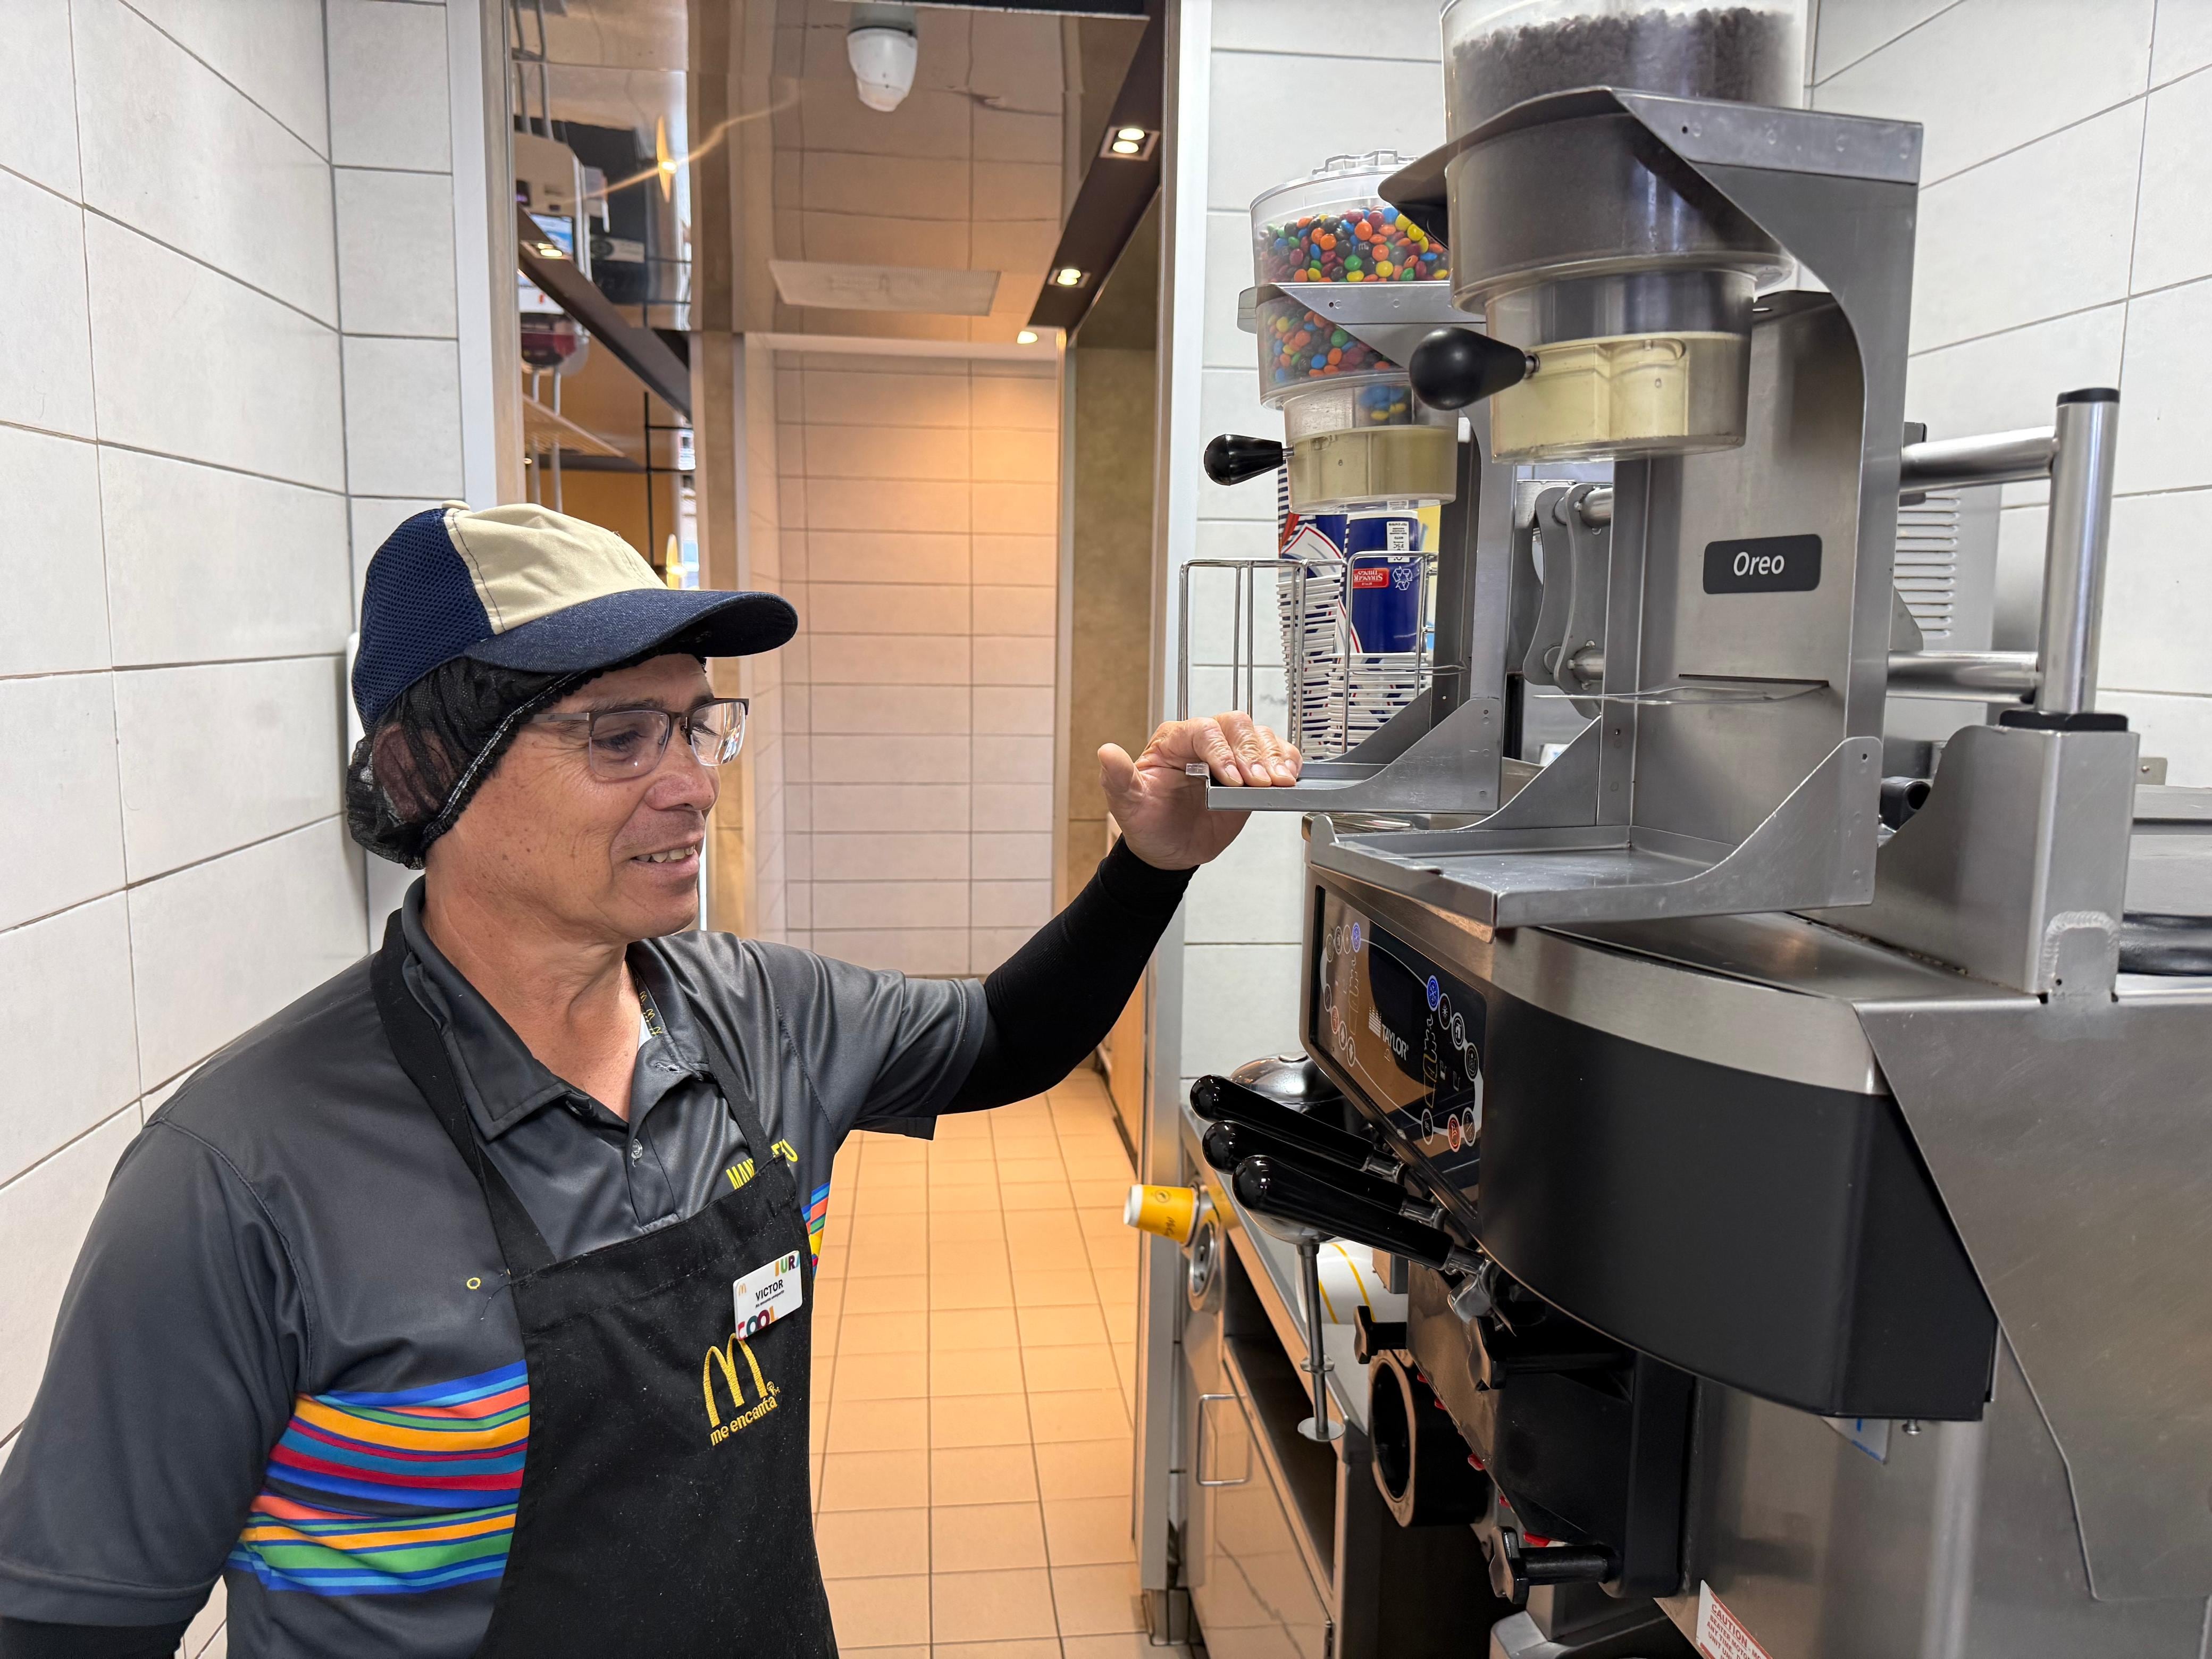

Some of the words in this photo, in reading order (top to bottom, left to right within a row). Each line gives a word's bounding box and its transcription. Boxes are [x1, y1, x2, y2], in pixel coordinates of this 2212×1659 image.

[1733, 551, 1785, 576] Oreo
[755, 1279, 783, 1301] VICTOR
[710, 1426, 730, 1446] me
[730, 1396, 778, 1433] encanta
[1707, 1621, 1718, 1636] ANY
[1710, 1614, 1730, 1641] BEATER
[1711, 1604, 1748, 1648] CAUTION
[1708, 1631, 1721, 1649] UNIT
